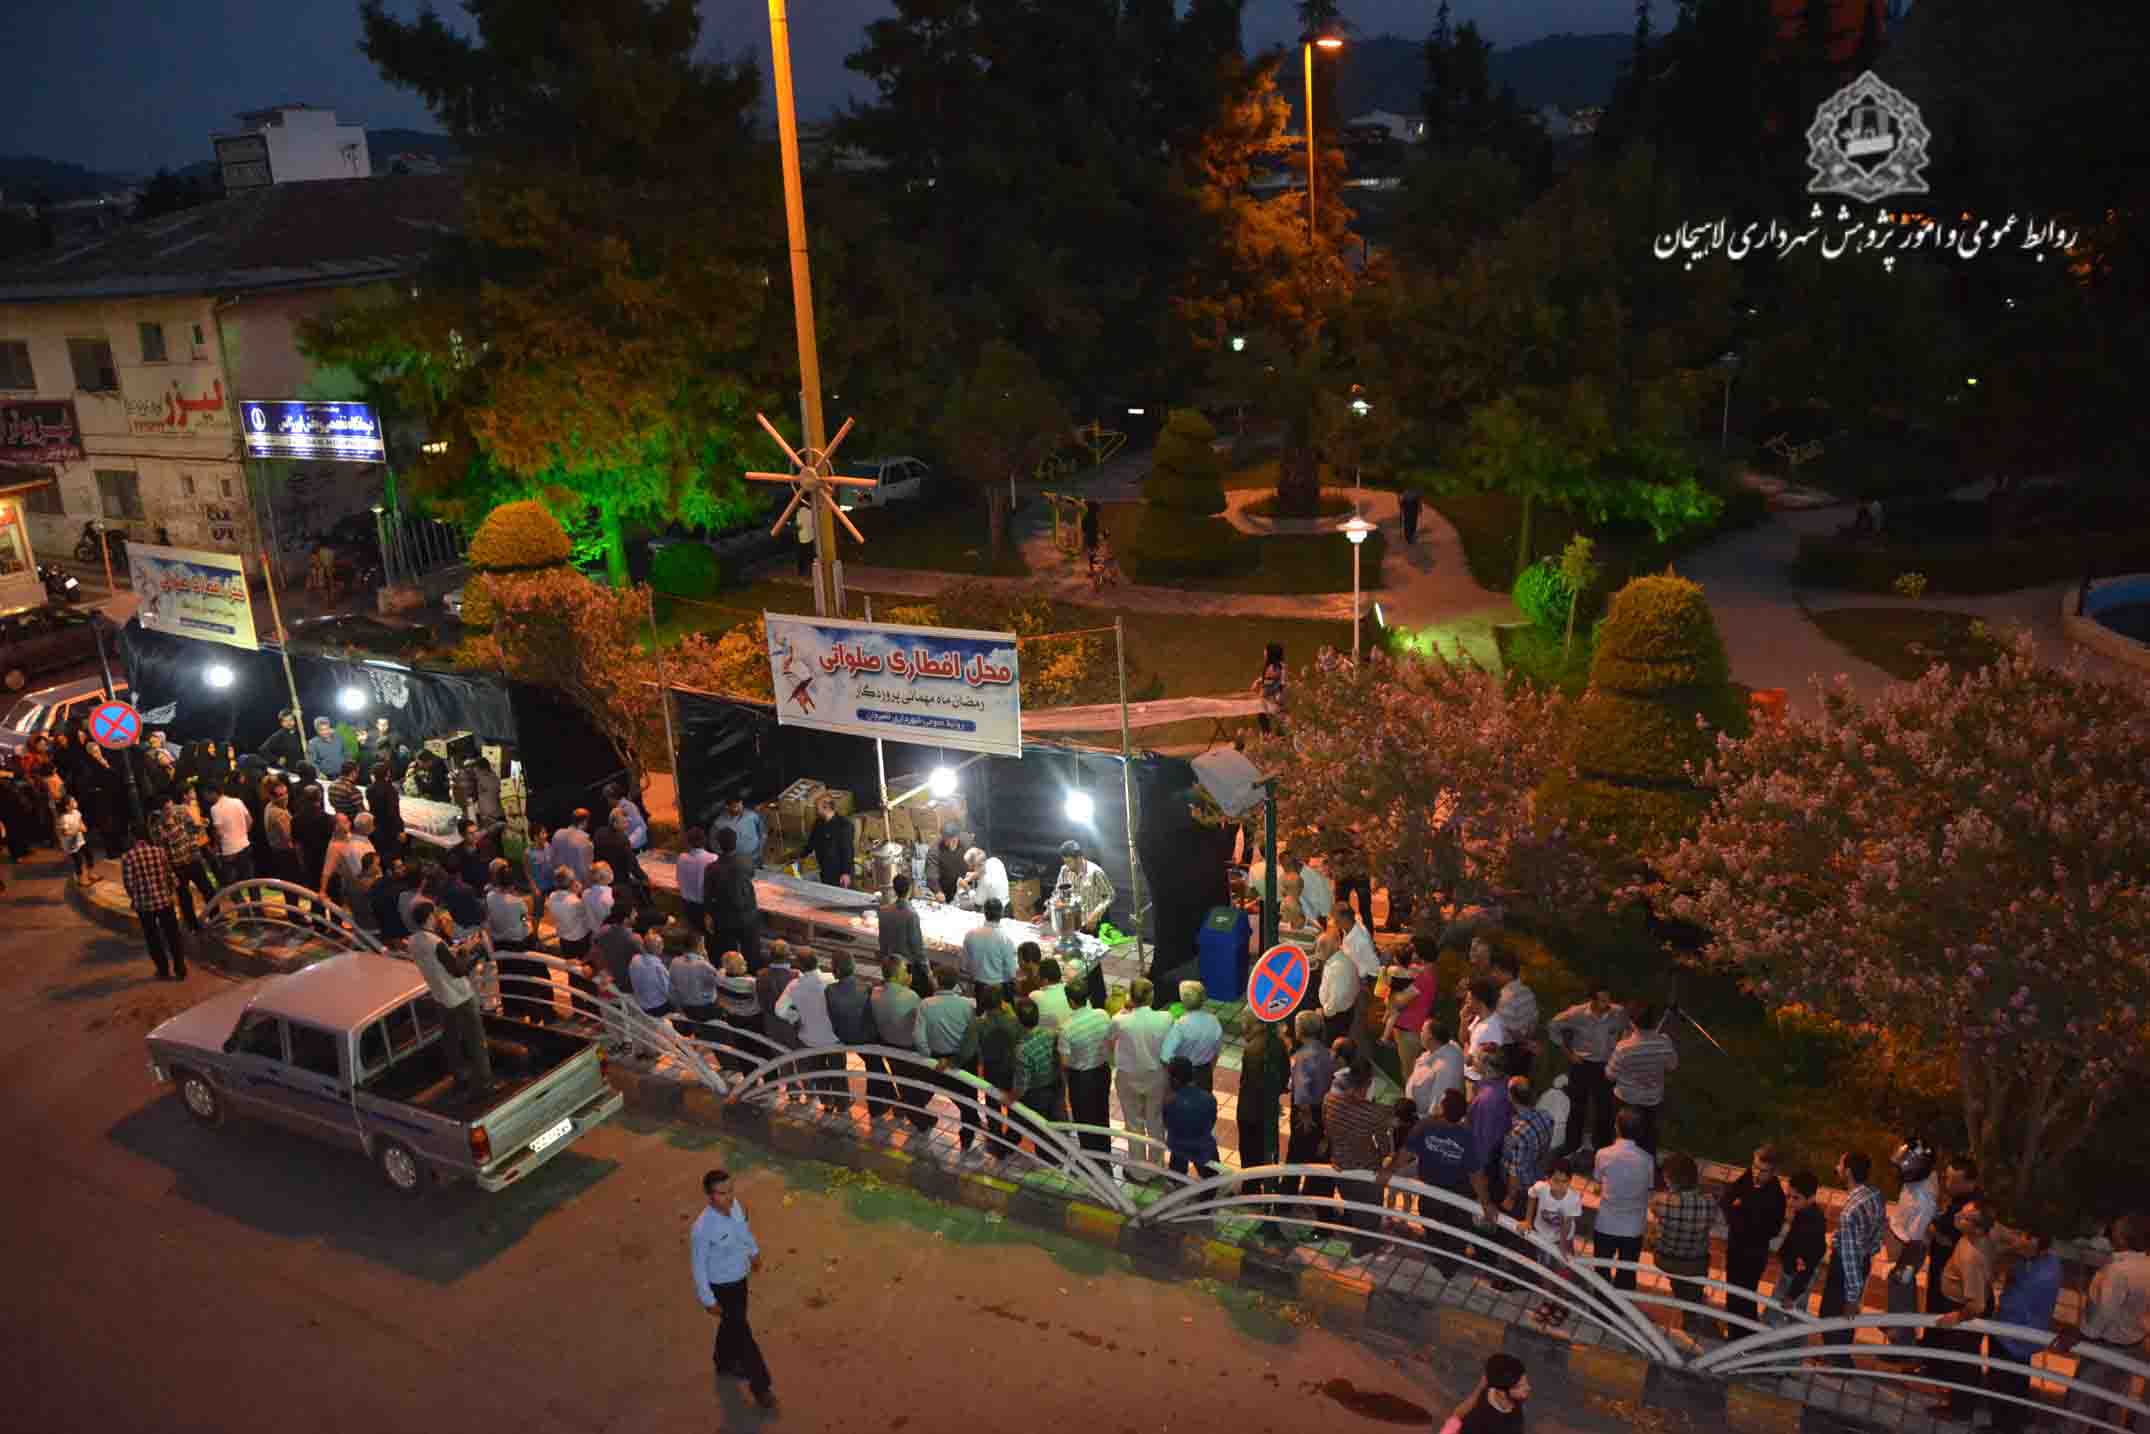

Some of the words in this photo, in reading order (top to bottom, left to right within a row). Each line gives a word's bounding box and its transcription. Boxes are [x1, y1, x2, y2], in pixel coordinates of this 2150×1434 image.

[818, 642, 882, 677] صلواتی
[885, 645, 962, 681] افطاری
[963, 652, 1014, 687] محل
[855, 684, 901, 705] پروردگار
[901, 688, 935, 707] مهمانی
[936, 693, 951, 705] ماه
[951, 693, 985, 712] رمضان
